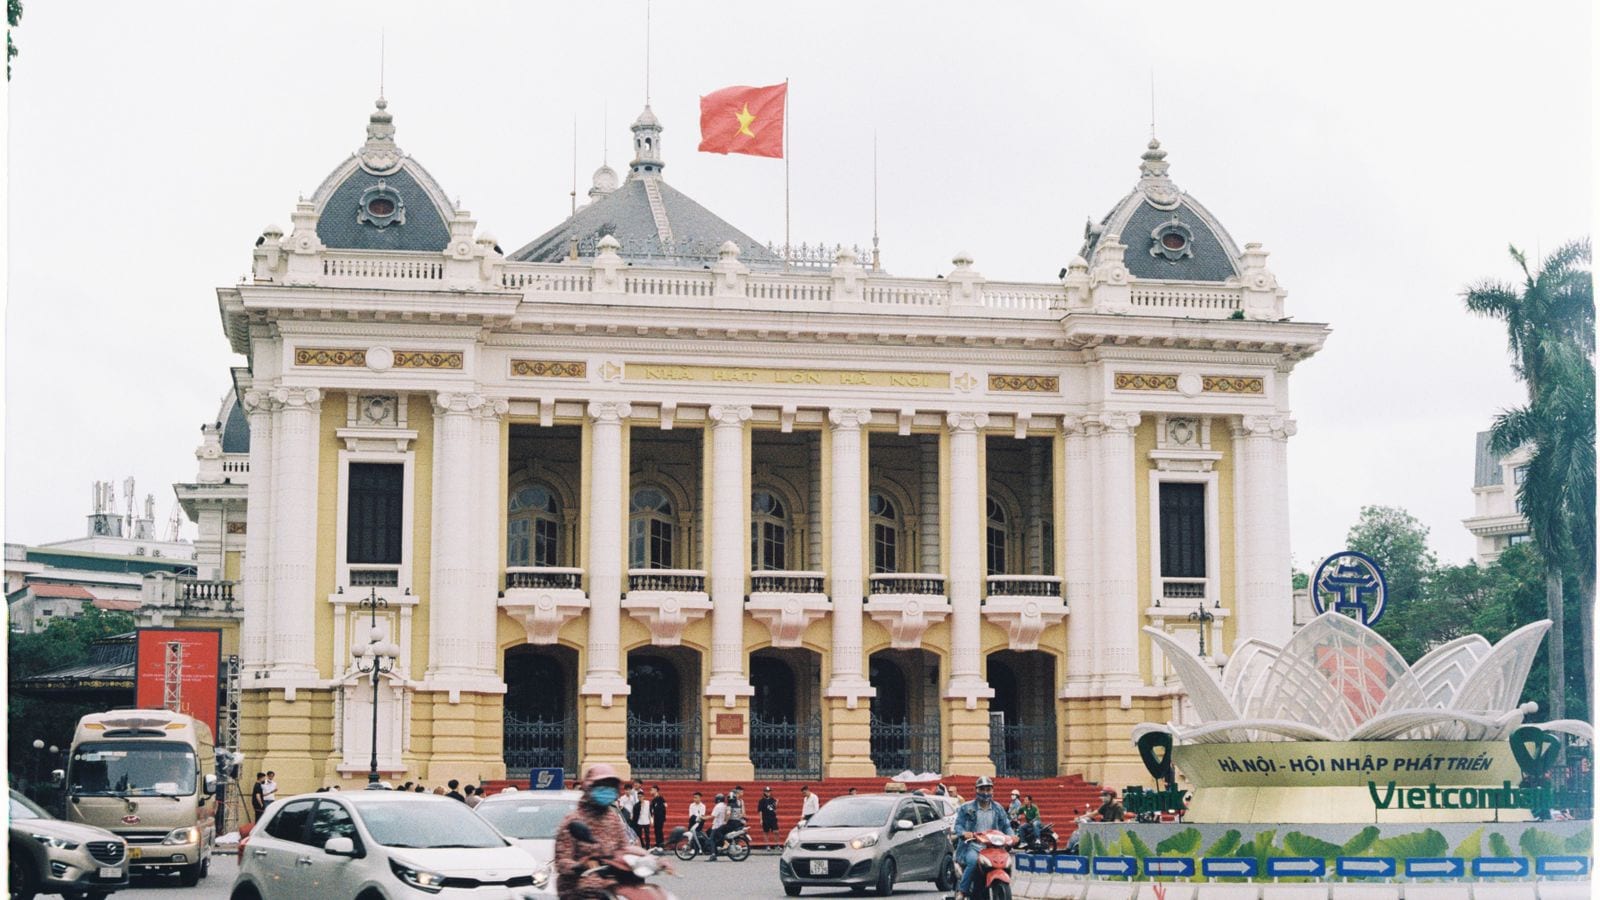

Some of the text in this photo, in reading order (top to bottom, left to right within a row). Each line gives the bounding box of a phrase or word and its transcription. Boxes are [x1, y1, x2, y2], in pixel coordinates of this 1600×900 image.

[1217, 756, 1243, 772] HÀ
[1242, 755, 1277, 776] NỘI
[1289, 755, 1326, 776] HỘI
[1331, 754, 1389, 775] NHẬP
[1393, 753, 1446, 771] PHÁT
[1446, 752, 1494, 771] TRIỂN
